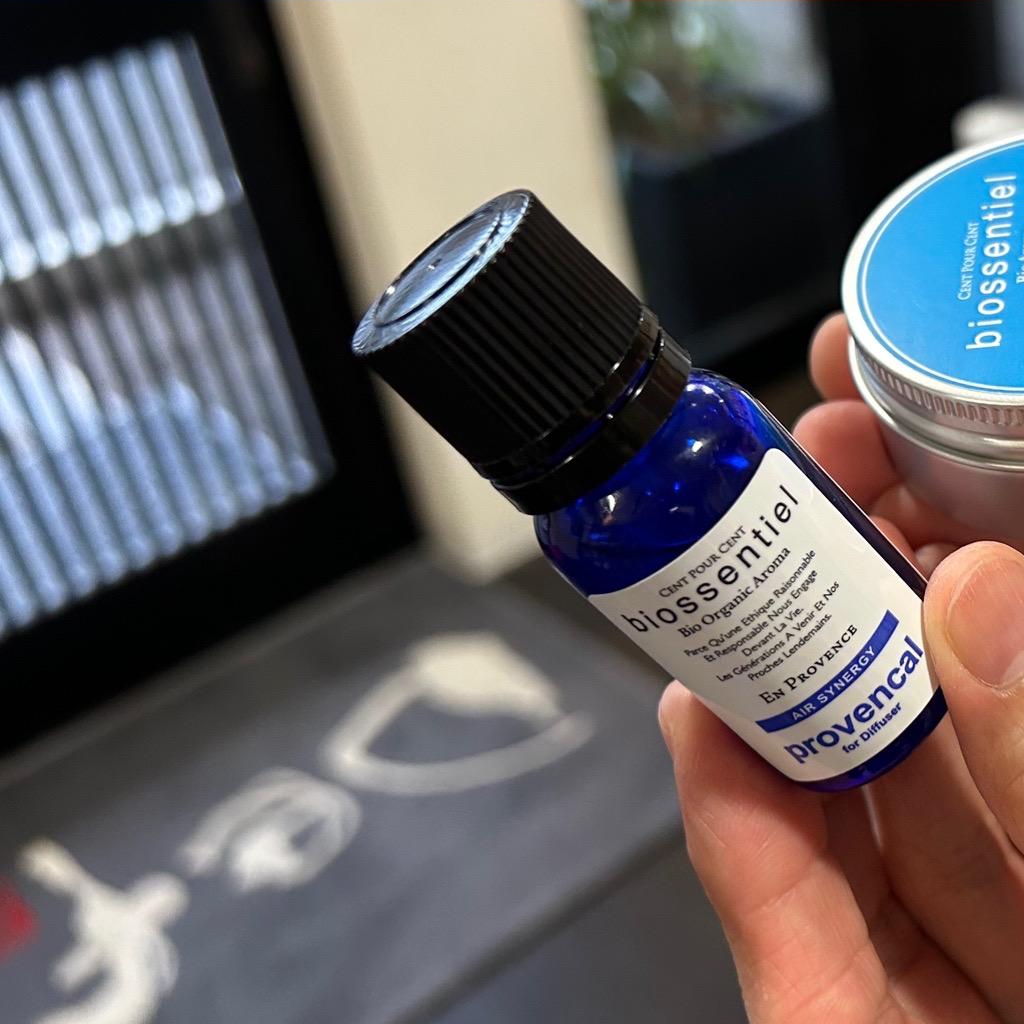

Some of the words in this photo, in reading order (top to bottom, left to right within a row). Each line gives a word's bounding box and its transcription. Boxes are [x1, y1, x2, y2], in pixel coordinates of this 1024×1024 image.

[960, 246, 977, 273] POUR
[963, 222, 979, 247] CENT
[966, 176, 1016, 349] biossentiel
[957, 273, 973, 301] CENT
[620, 485, 798, 633] biossentiel
[658, 576, 690, 598] CENT
[688, 552, 721, 579] POUR
[717, 525, 747, 555] CENT
[677, 623, 703, 638] Bio
[700, 585, 754, 626] Organic
[752, 547, 791, 589] Aroma
[683, 645, 709, 657] Parce
[707, 624, 743, 648] Qu'une
[741, 597, 775, 627] Ethique
[773, 549, 816, 598] Raisonnable
[703, 654, 717, 663] Et
[714, 620, 769, 658] Responsable
[767, 598, 793, 622] Nous
[791, 569, 818, 600] Engage
[716, 672, 733, 682] Les
[784, 631, 795, 641] A
[792, 609, 816, 632] Venir
[814, 600, 826, 612] Et
[823, 581, 840, 601] Nos
[741, 631, 775, 657] Devant
[774, 621, 788, 633] La
[785, 606, 805, 621] Vie.
[747, 656, 785, 681] Proches
[781, 613, 833, 659] Lendemains.
[758, 687, 785, 705] EN
[783, 624, 858, 691] PROVENCE
[791, 702, 817, 721] AIR
[817, 646, 876, 704] SYNERGY
[784, 636, 923, 764] provencal
[841, 739, 861, 754] for
[859, 702, 902, 743] Diffuser
